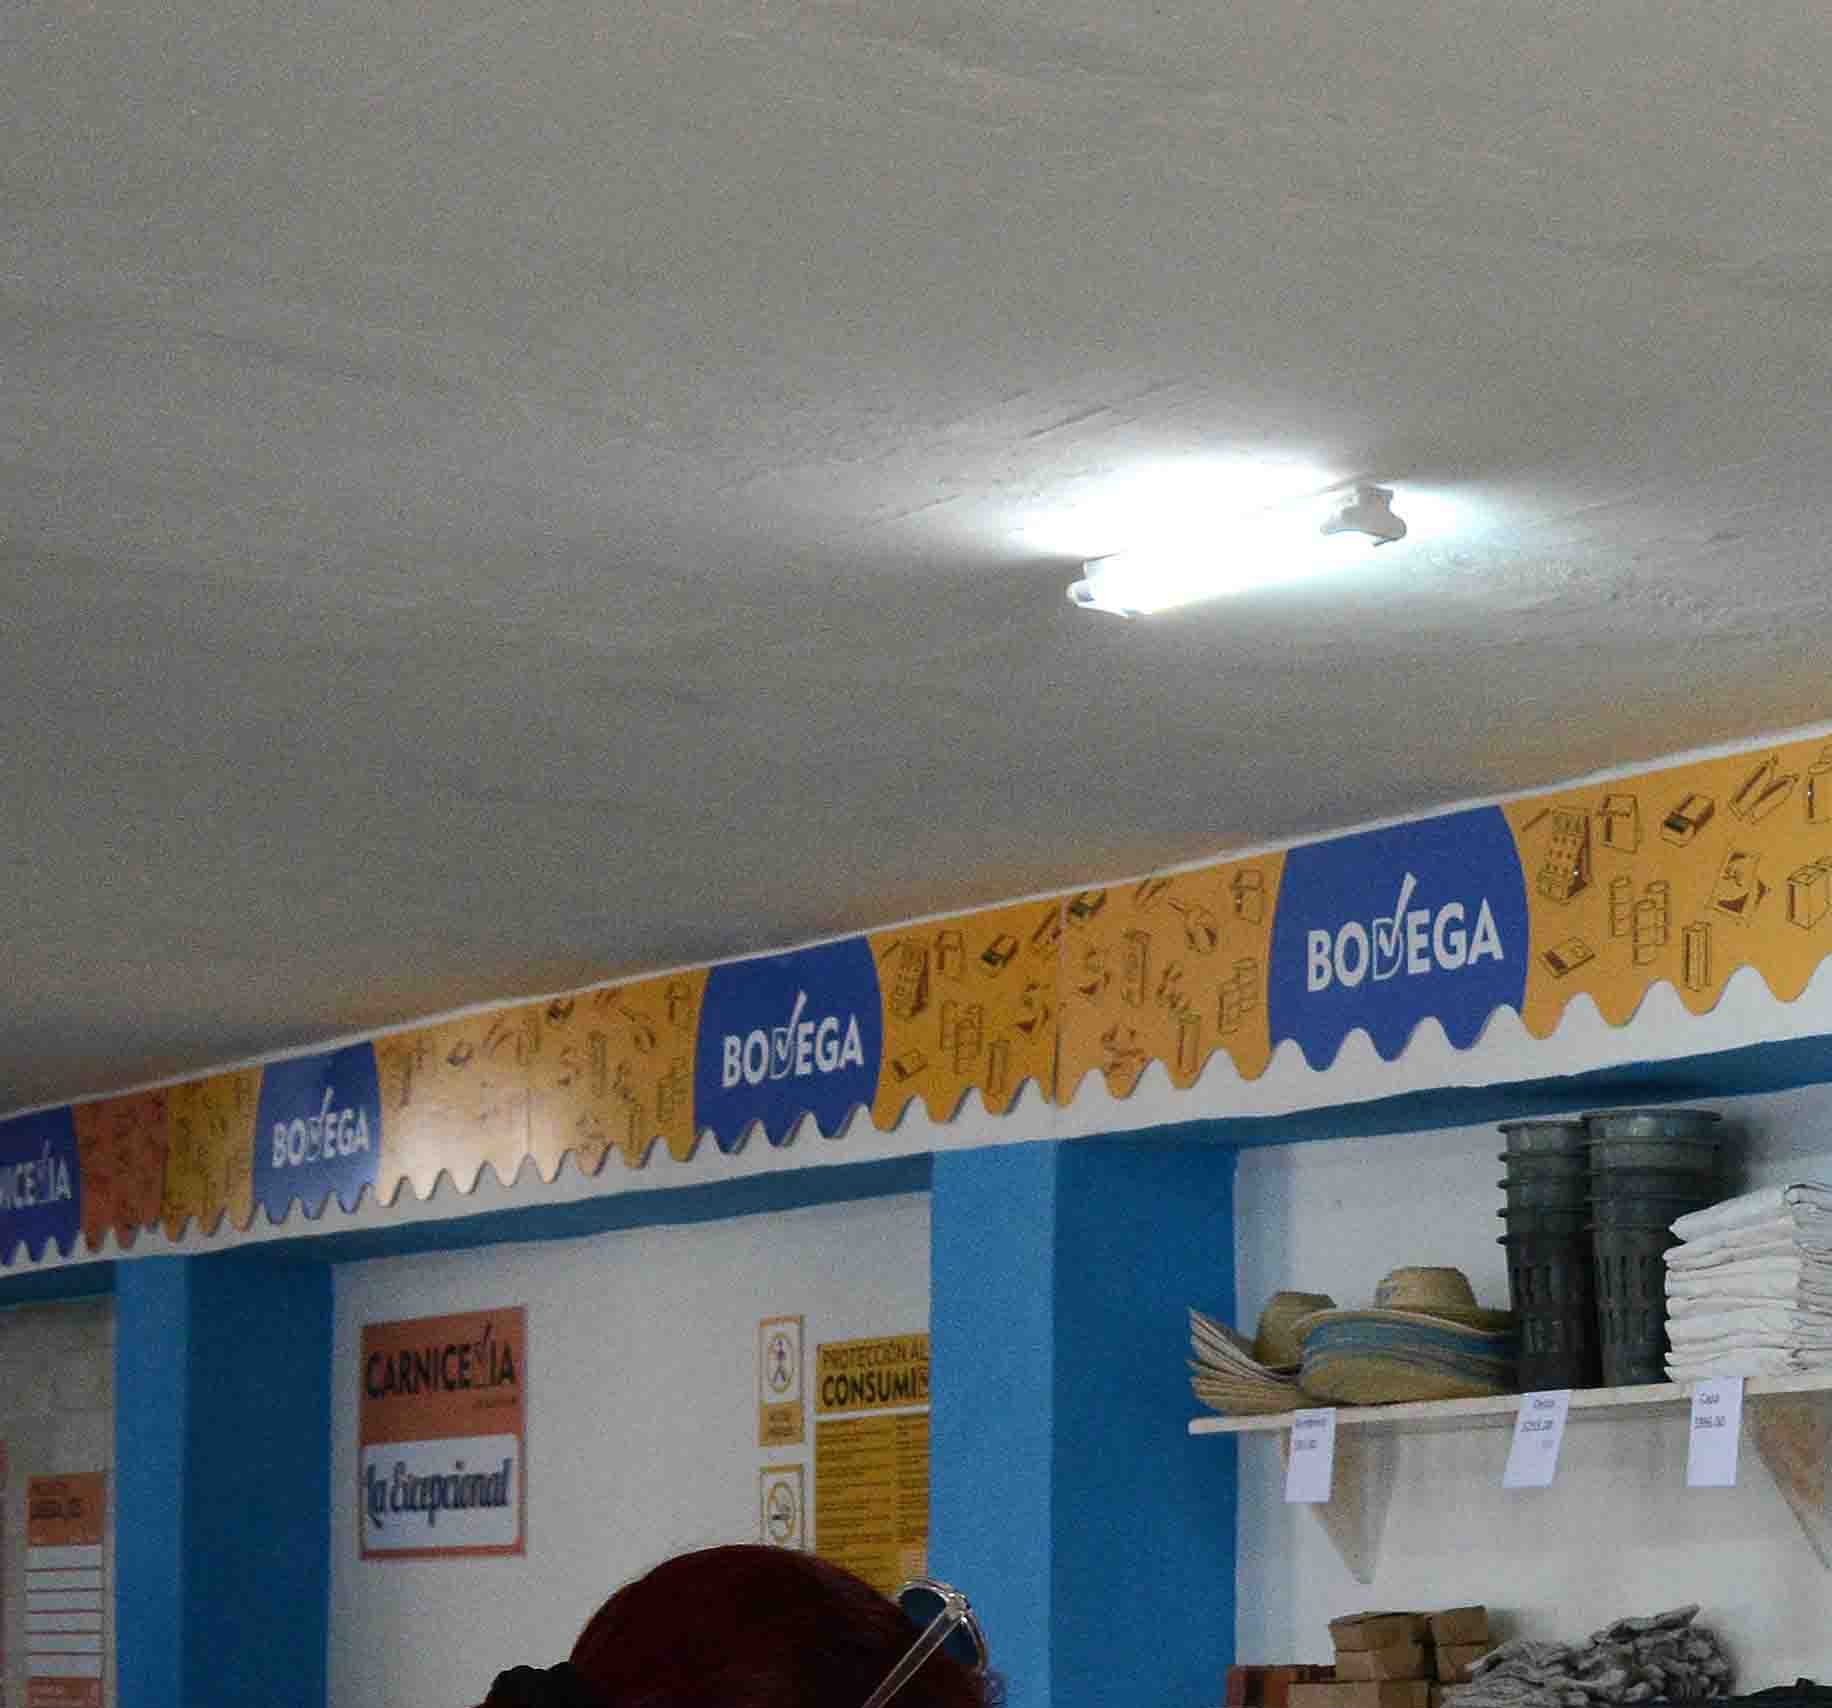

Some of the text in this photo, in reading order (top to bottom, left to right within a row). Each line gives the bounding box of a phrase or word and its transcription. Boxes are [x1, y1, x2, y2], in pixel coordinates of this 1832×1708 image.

[1306, 873, 1504, 991] BODEGA
[722, 991, 864, 1087] BODEGA
[272, 1086, 369, 1168] BODEGA
